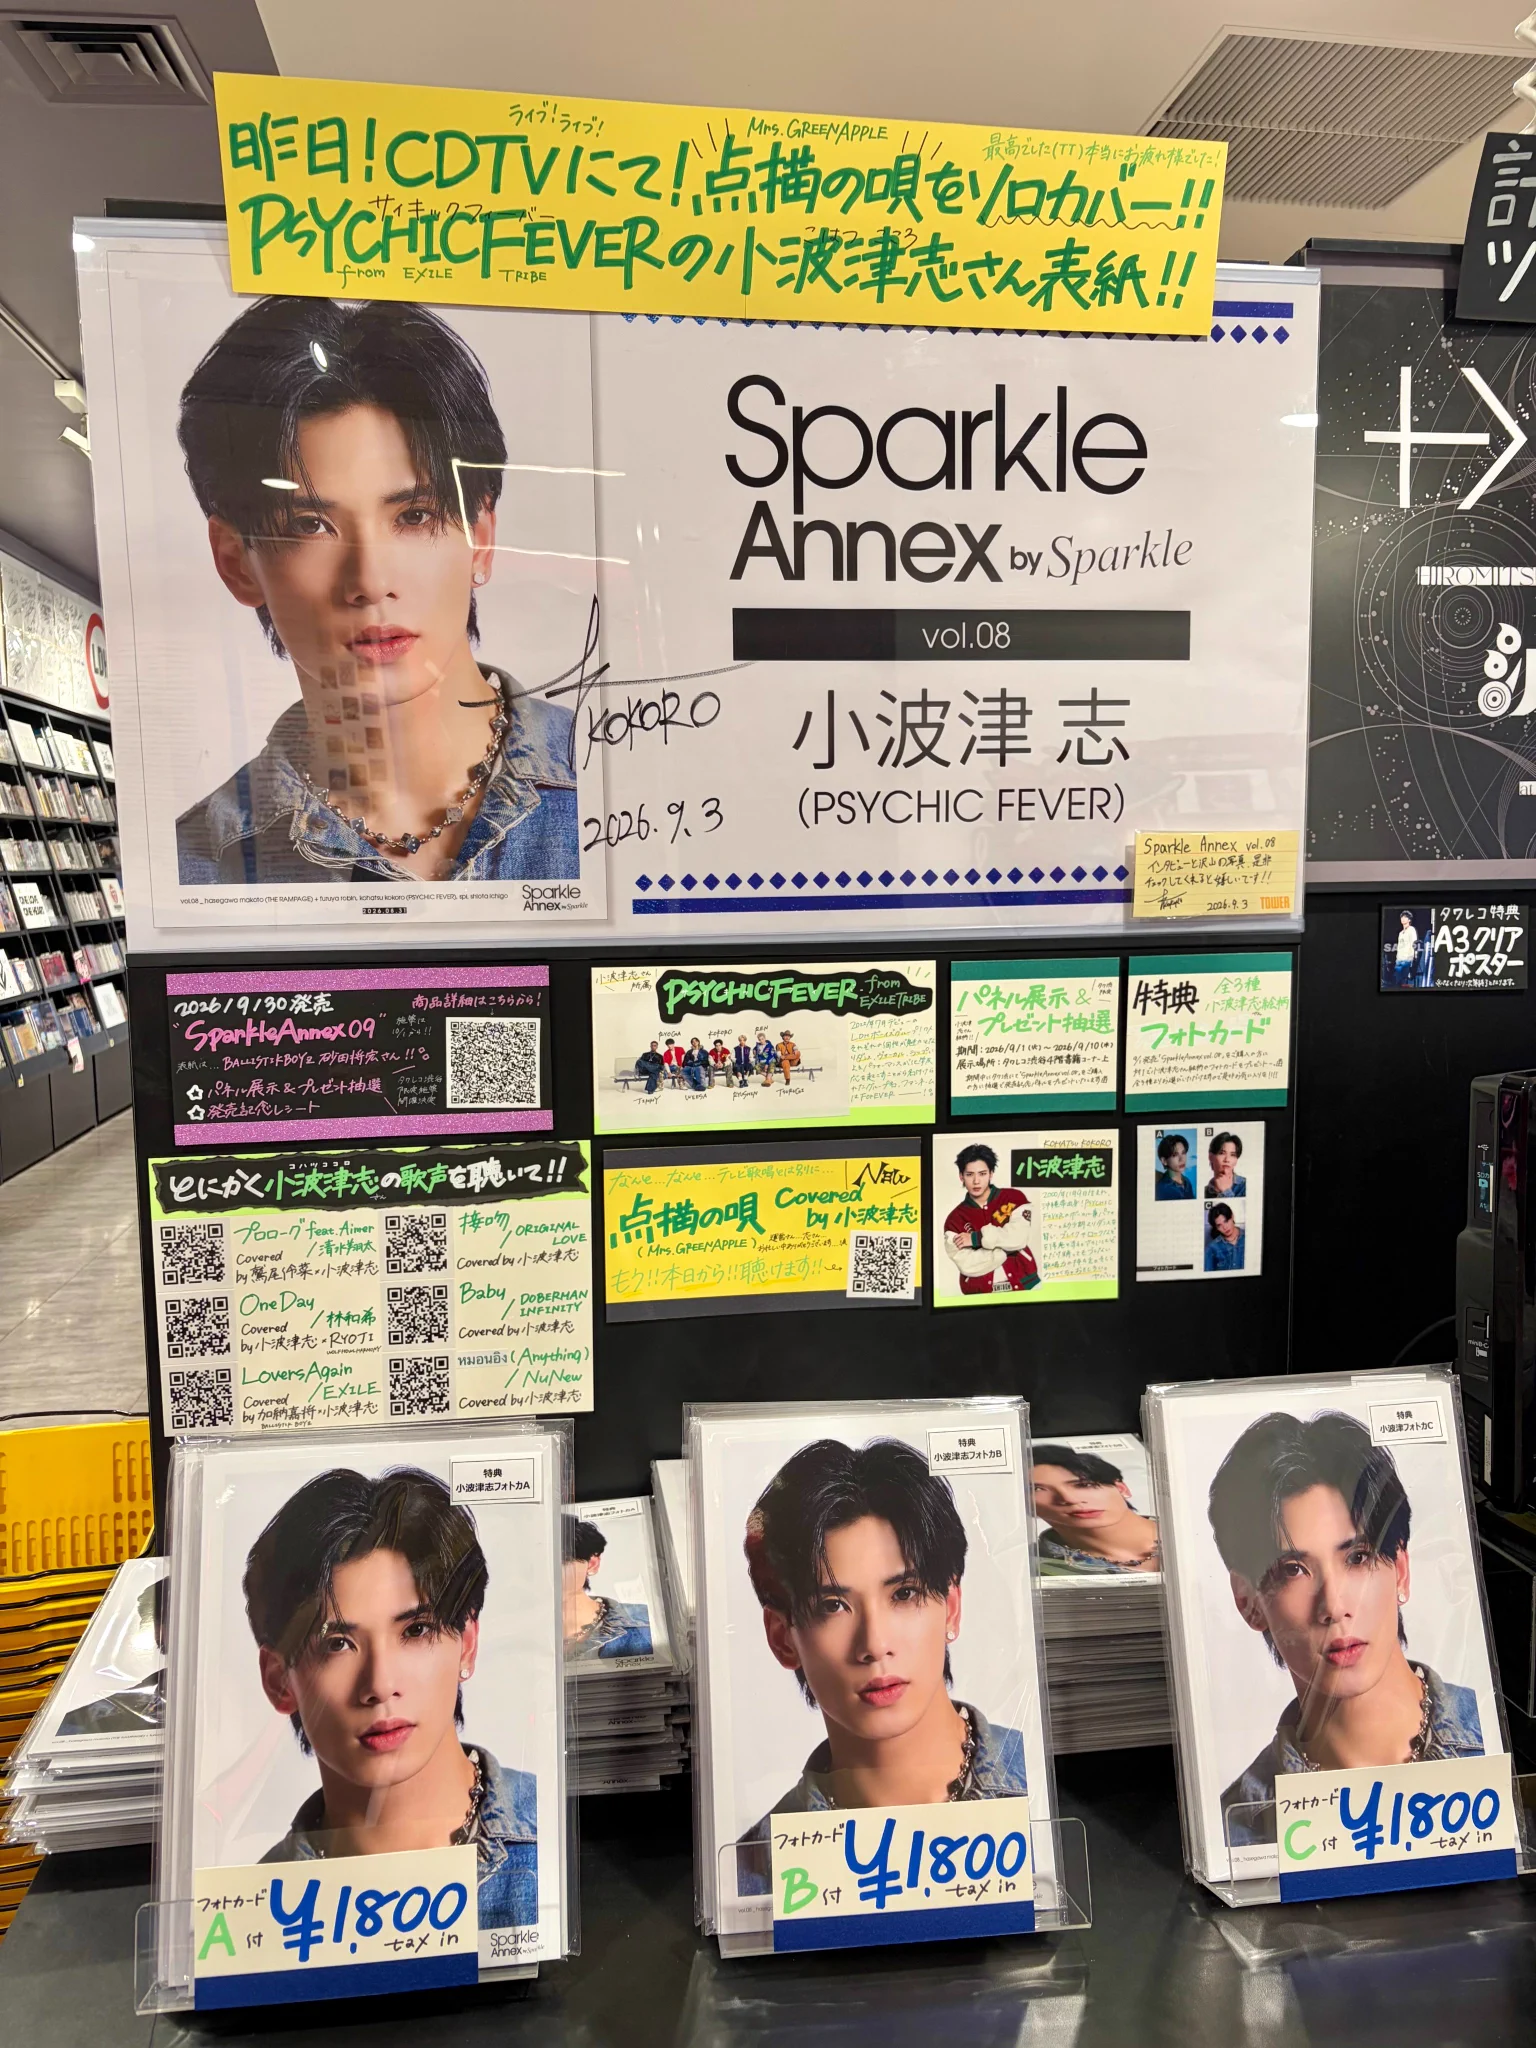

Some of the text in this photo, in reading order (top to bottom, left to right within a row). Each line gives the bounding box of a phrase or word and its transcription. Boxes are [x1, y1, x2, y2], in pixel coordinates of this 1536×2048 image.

[337, 265, 547, 290] from EXILE TRIBE
[725, 374, 1148, 515] Sparkle
[729, 500, 1193, 586] Annex by Sparkle
[921, 620, 1012, 650] vol.08
[582, 688, 721, 770] KOKORO
[792, 687, 1131, 770] 小波津 志
[798, 786, 1125, 827] (PSYCHIC FEVER)
[1144, 838, 1192, 856] Sparkle
[1200, 835, 1238, 852] Annex
[522, 884, 581, 901] Sparkle
[1260, 896, 1290, 910] TOWER
[523, 901, 561, 912] Annex
[1440, 904, 1521, 922] タワレコ特典
[1434, 925, 1524, 953] A3クリア
[1448, 953, 1525, 978] ポスター
[865, 975, 901, 995] from
[1213, 975, 1262, 994] 全3種
[1132, 979, 1200, 1016] 特典
[978, 1009, 1115, 1037] プレゼント抽選
[1140, 1017, 1271, 1050] フォトカード
[1205, 1128, 1212, 1136] B
[1015, 1153, 1106, 1180] 小波津志
[609, 1183, 864, 1250] 点描の唄 Covered
[806, 1203, 918, 1230] by 小波津志
[1205, 1202, 1212, 1210] C
[233, 1218, 305, 1245] プロローグ
[458, 1210, 511, 1235] 接吻
[552, 1233, 588, 1246] LOVE
[236, 1251, 284, 1266] Covered
[457, 1248, 580, 1270] Covered by 小波津志
[236, 1270, 248, 1284] by
[459, 1281, 589, 1306] Baby DOBERMAN
[519, 1301, 583, 1317] INFINITY
[241, 1321, 289, 1336] Covered
[459, 1318, 575, 1339] Covered by 小波津志
[241, 1339, 253, 1355] by
[243, 1393, 290, 1410] Covered
[458, 1388, 582, 1409] Covered by 小波津志
[242, 1411, 255, 1424] by
[1396, 1410, 1413, 1420] 特典
[1380, 1421, 1434, 1434] 小波津フォトカC
[958, 1438, 976, 1448] 特典
[933, 1450, 1003, 1462] 小波津志フォトカB
[483, 1468, 503, 1478] 特典
[456, 1481, 531, 1493] 小波津志フォトカA
[1279, 1788, 1340, 1814] フォトカード
[774, 1822, 845, 1850] フォトカード
[1283, 1819, 1317, 1861] C
[1430, 1831, 1470, 1851] tax
[1476, 1830, 1493, 1843] in
[197, 1888, 268, 1913] フォトカード
[780, 1866, 819, 1915] B
[945, 1879, 991, 1901] tax
[998, 1877, 1017, 1893] in
[197, 1912, 237, 1960] A
[384, 1934, 430, 1953] tax
[440, 1931, 459, 1946] in
[490, 1929, 540, 1950] Sparkle
[491, 1947, 523, 1958] Annex
